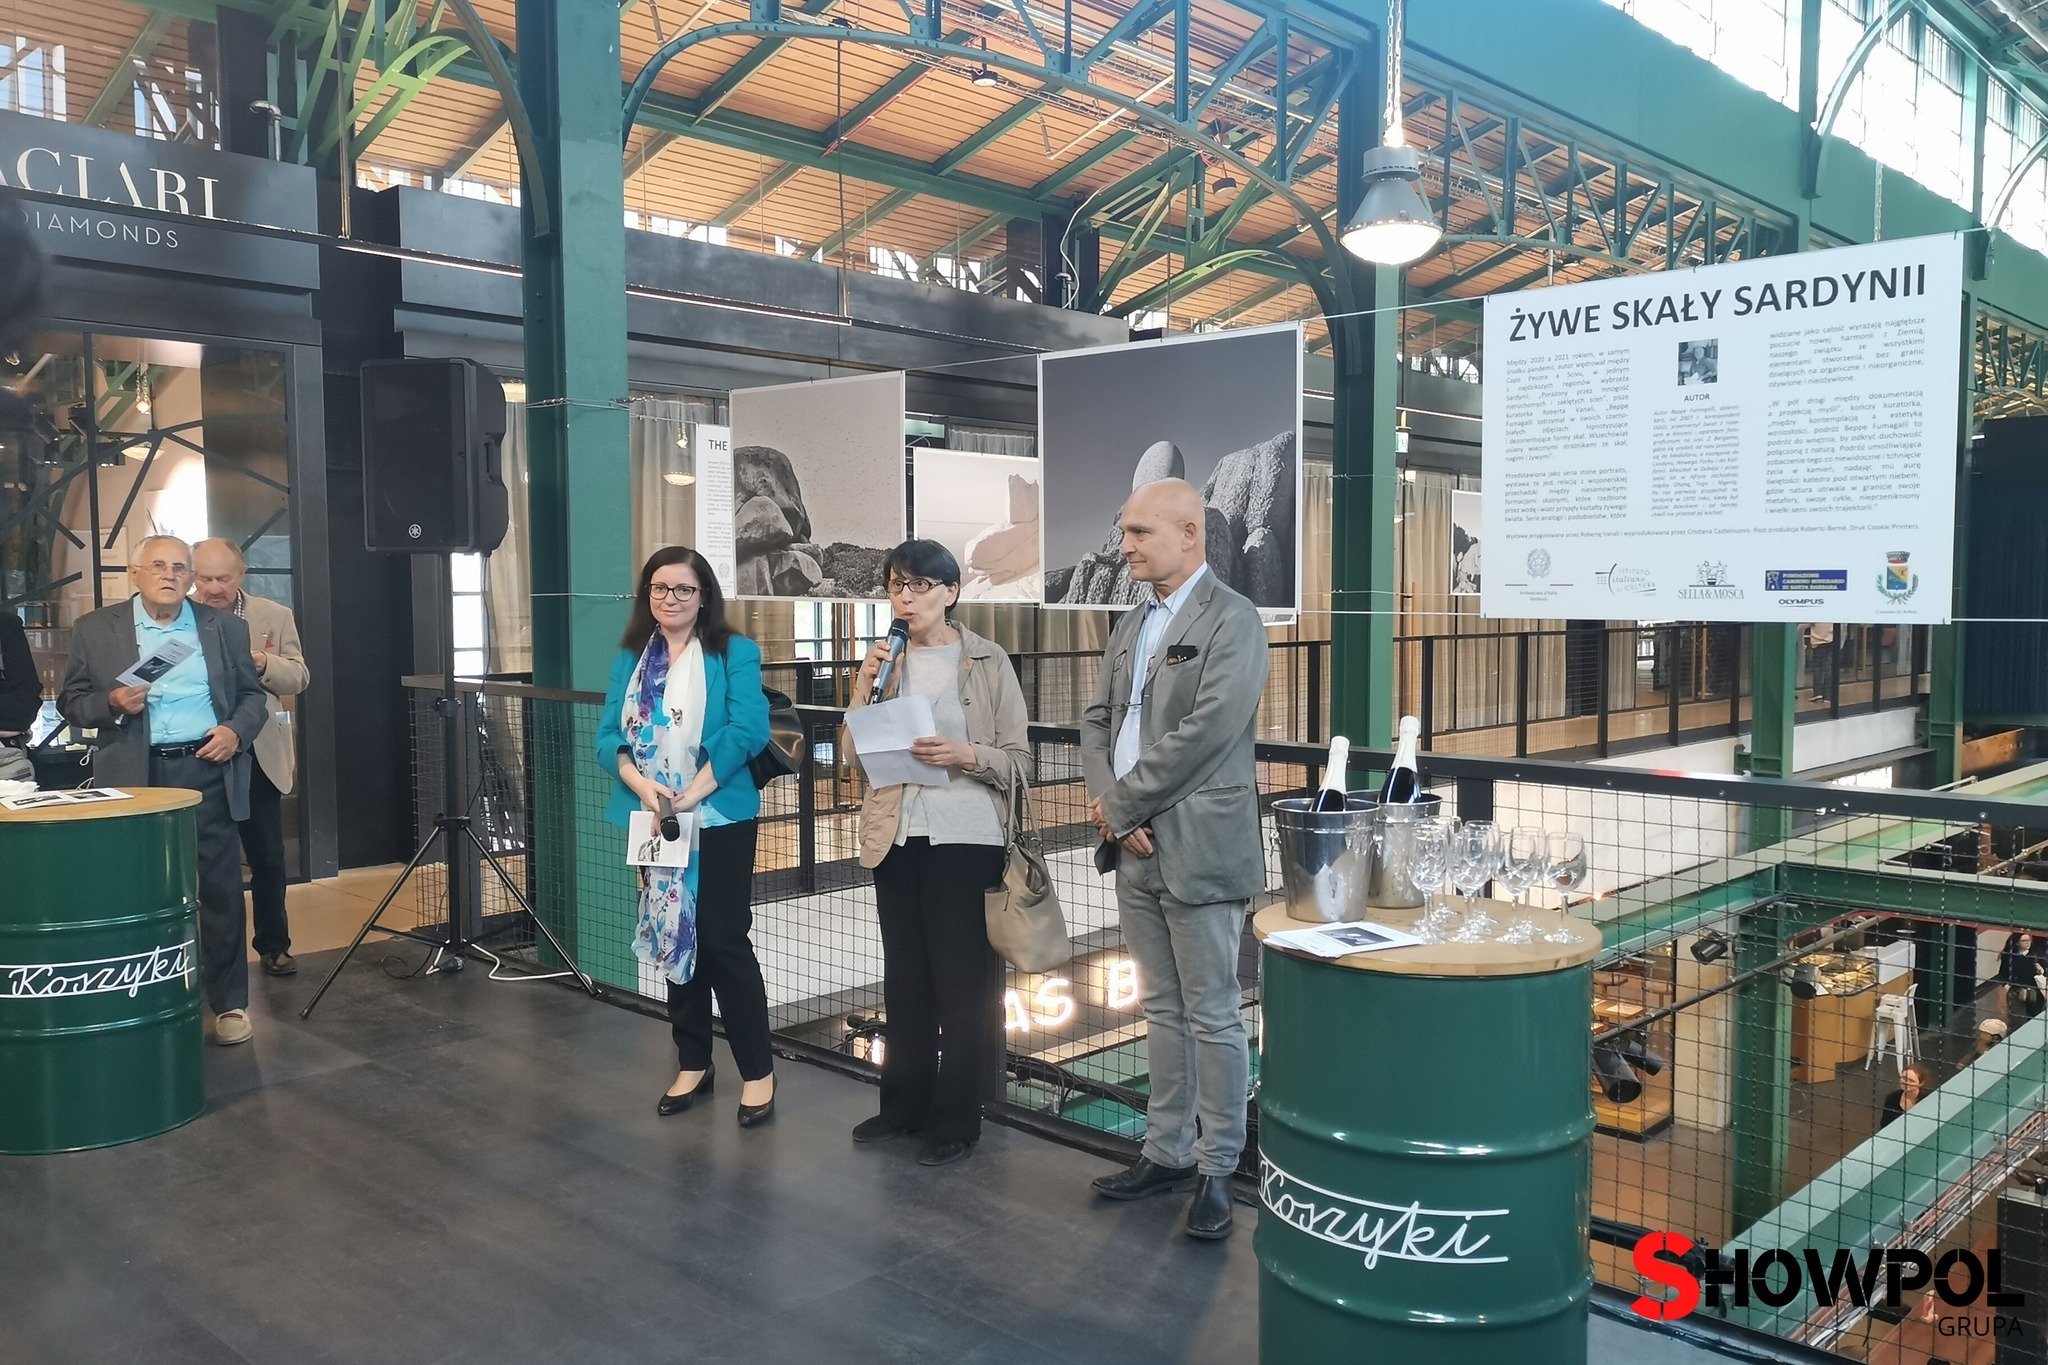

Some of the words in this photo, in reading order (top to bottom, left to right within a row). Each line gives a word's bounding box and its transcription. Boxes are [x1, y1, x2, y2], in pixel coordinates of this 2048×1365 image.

[1509, 304, 1600, 342] ŻYWE
[1612, 289, 1722, 328] SKAŁY
[1734, 264, 1926, 316] SARDYNII
[1684, 393, 1710, 402] AUTOR
[709, 439, 728, 451] THE
[1678, 589, 1744, 599] SELLA&MOSCA
[8, 945, 190, 998] Koszyki
[1259, 1160, 1490, 1270] Koszyki
